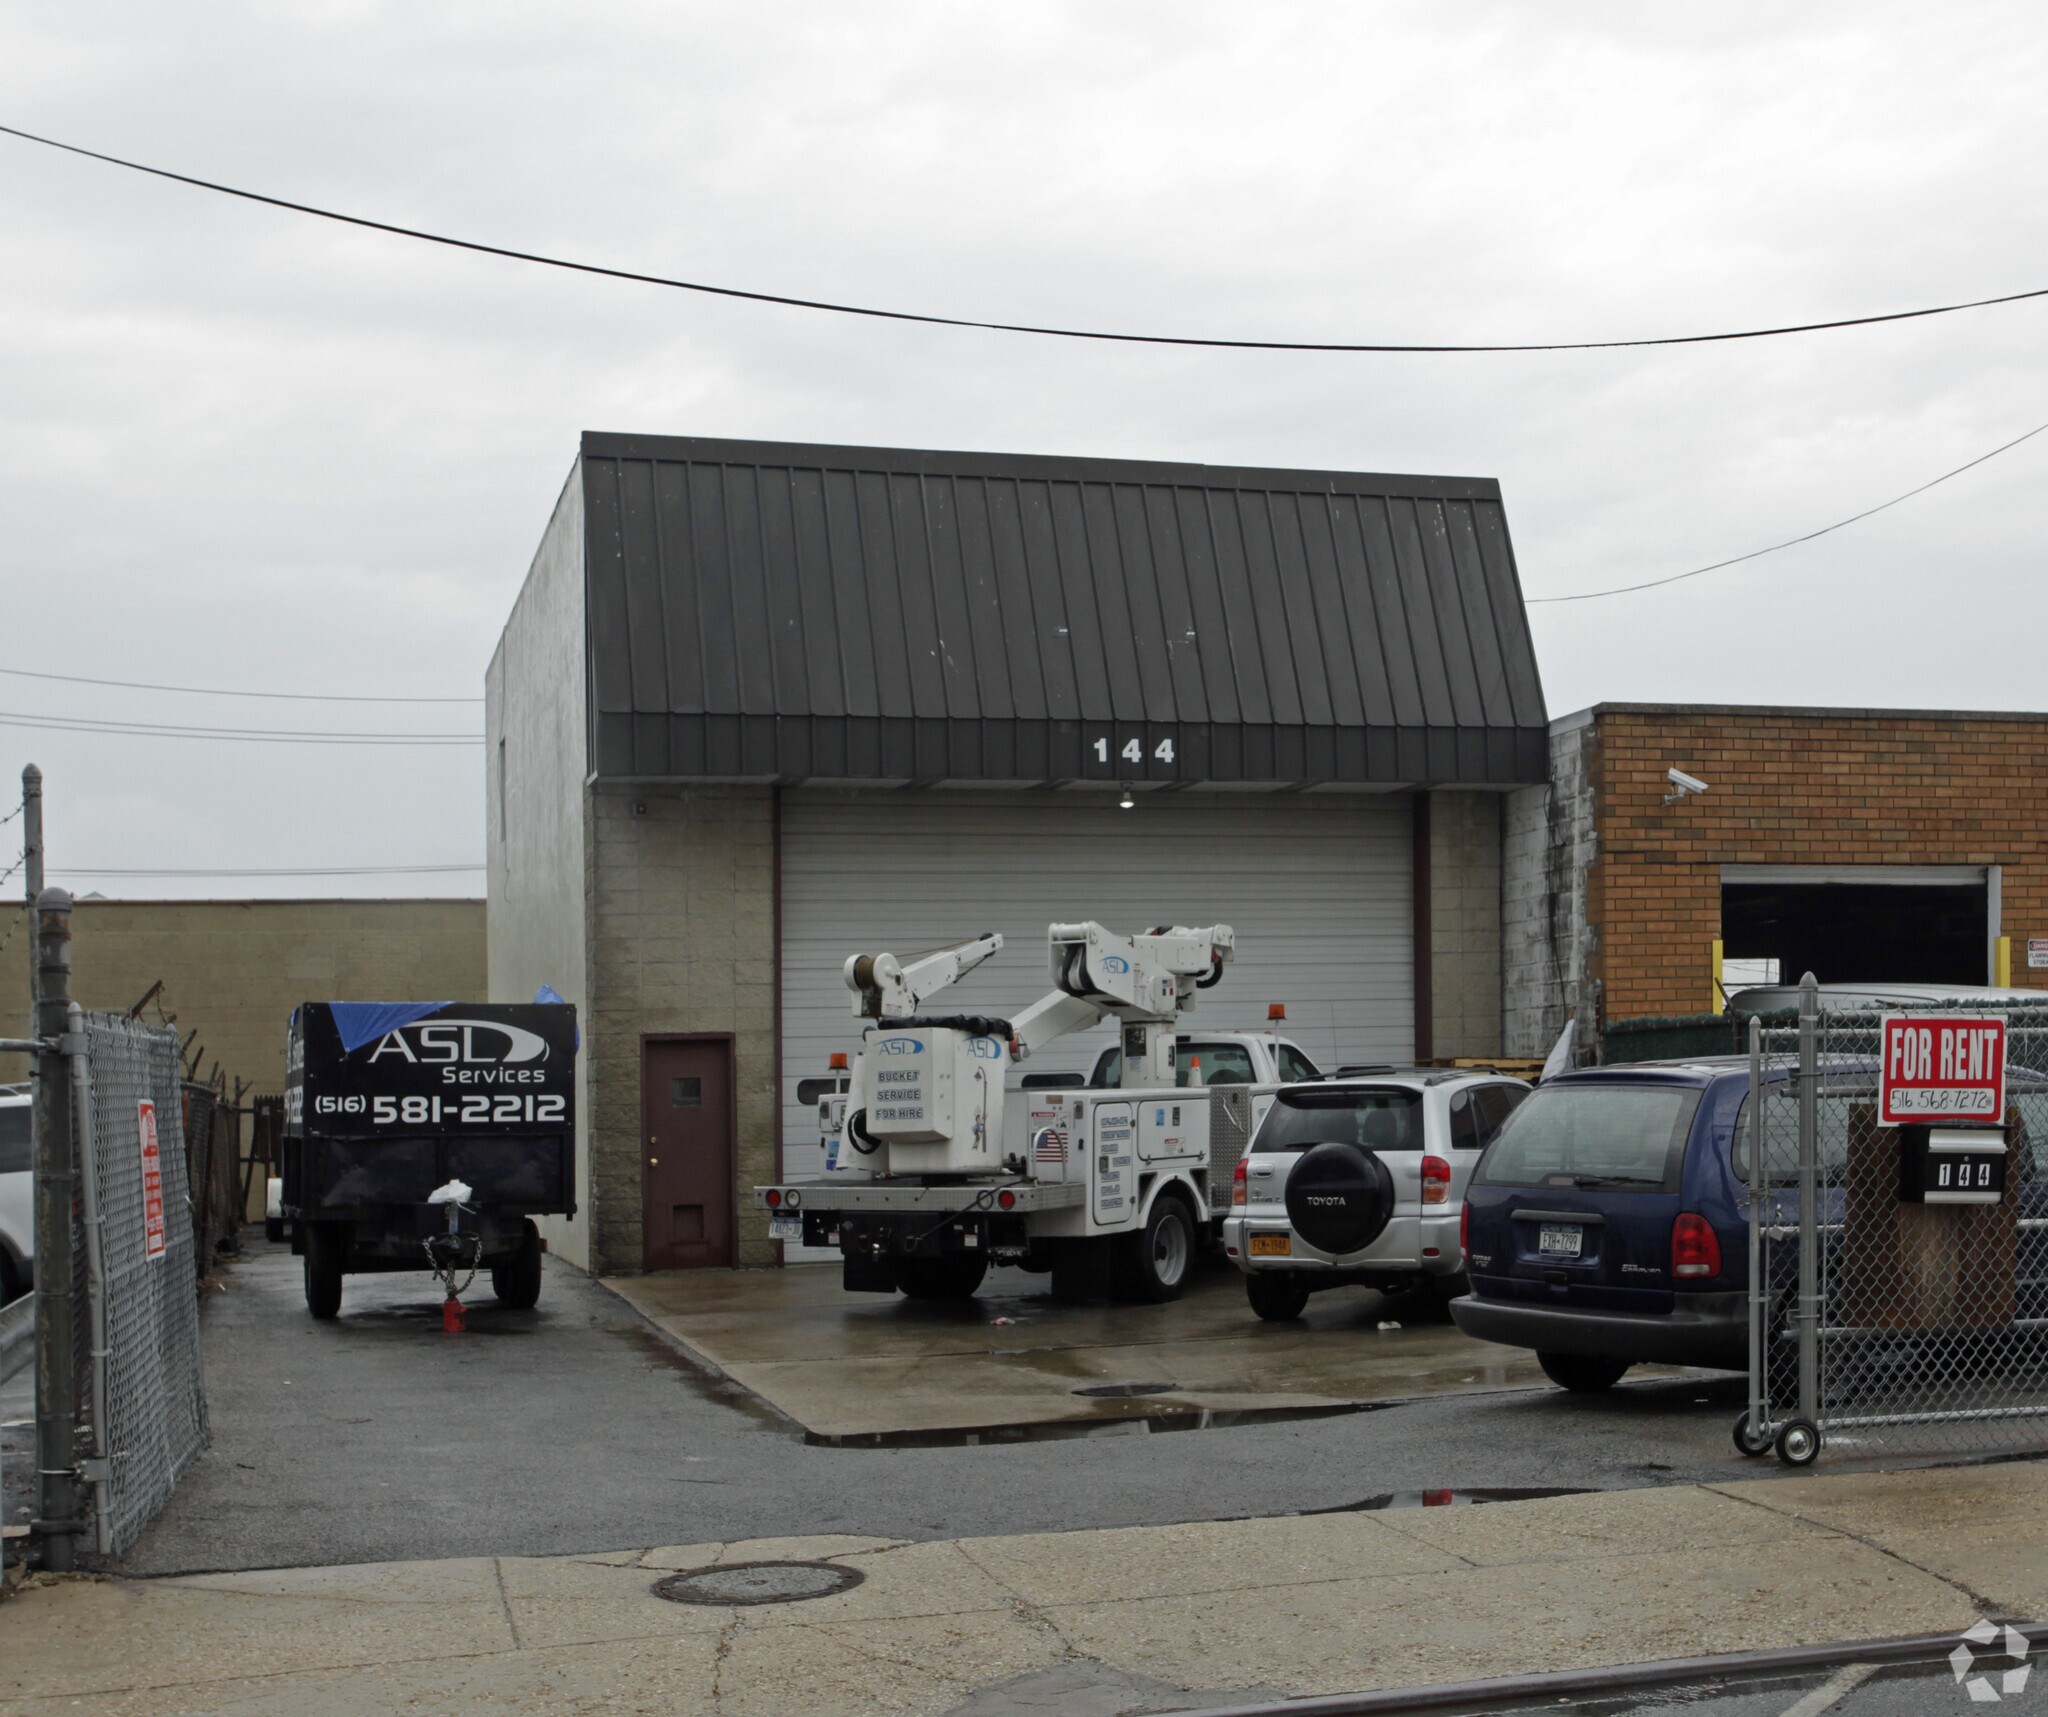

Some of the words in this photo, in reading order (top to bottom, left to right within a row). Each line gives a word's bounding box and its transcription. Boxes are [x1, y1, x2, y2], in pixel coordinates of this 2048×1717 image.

[1093, 737, 1175, 763] 144
[367, 1026, 497, 1063] ASL
[1890, 1027, 1933, 1081] FOR
[1939, 1028, 1999, 1081] RENT
[442, 1066, 546, 1084] Services
[878, 1070, 921, 1083] BUCKET
[876, 1089, 922, 1102] SERVICE
[1890, 1090, 1913, 1110] 516
[1917, 1090, 1988, 1110] 568-7272
[314, 1095, 367, 1114] (516)
[373, 1095, 566, 1124] 581-2212
[875, 1107, 896, 1121] FOR
[899, 1106, 924, 1119] HIRE
[1940, 1164, 1989, 1186] 144
[1306, 1196, 1347, 1206] TOYOTA
